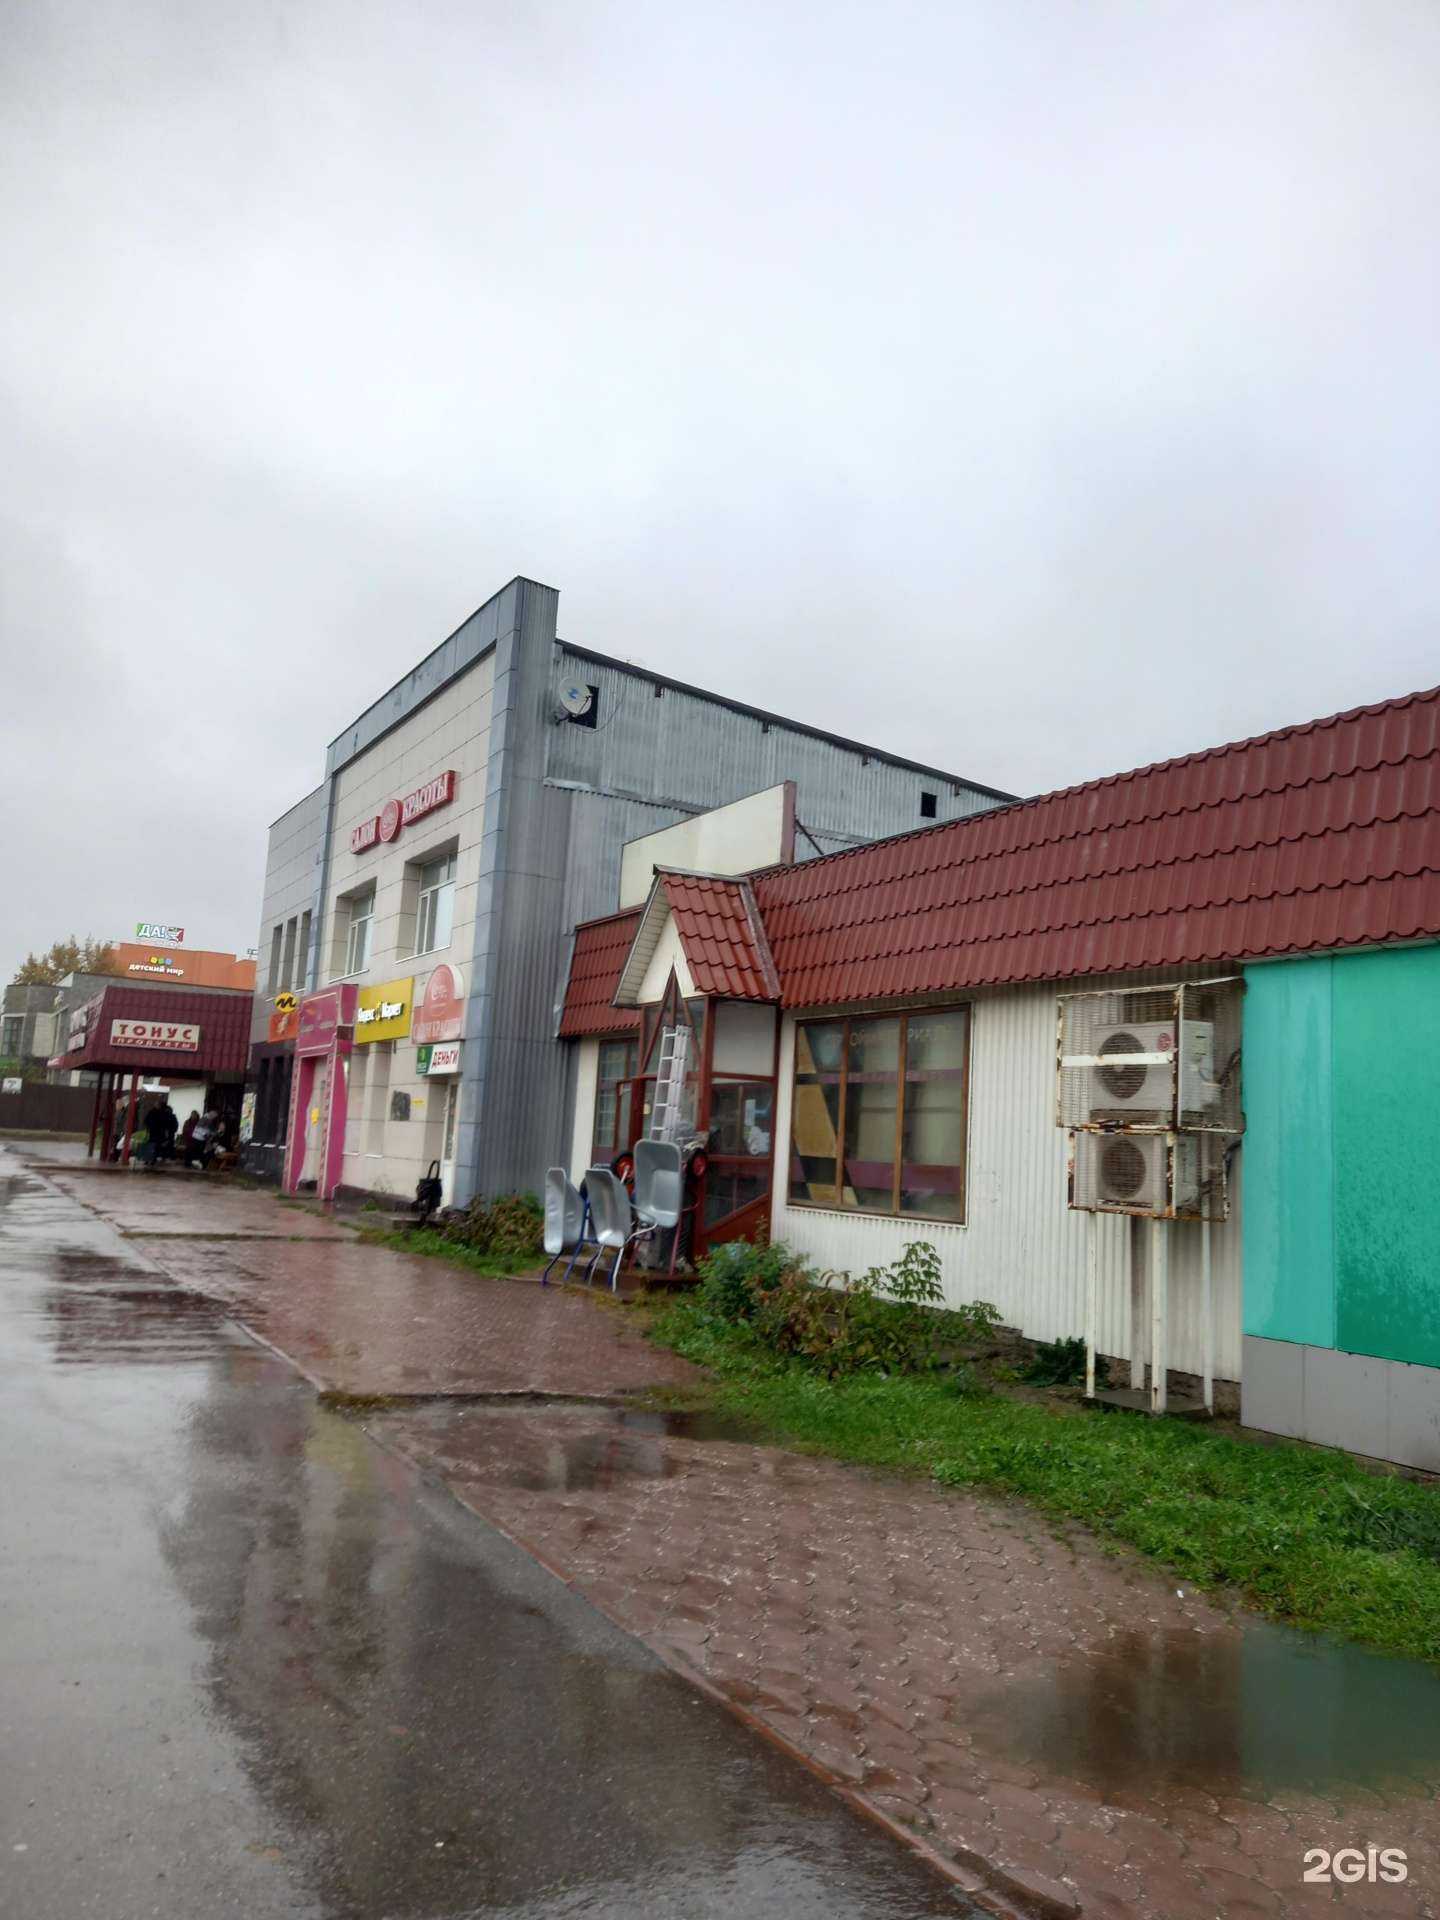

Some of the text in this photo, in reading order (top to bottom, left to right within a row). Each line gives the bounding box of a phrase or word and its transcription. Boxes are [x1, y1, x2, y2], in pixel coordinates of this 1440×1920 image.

[402, 773, 449, 821] КРАСОТЫ
[129, 963, 184, 977] детский мир
[119, 1024, 193, 1040] ТОНУС
[117, 1037, 191, 1049] ПРОДУКТЫ
[432, 1049, 459, 1068] ДЕНЬГИ
